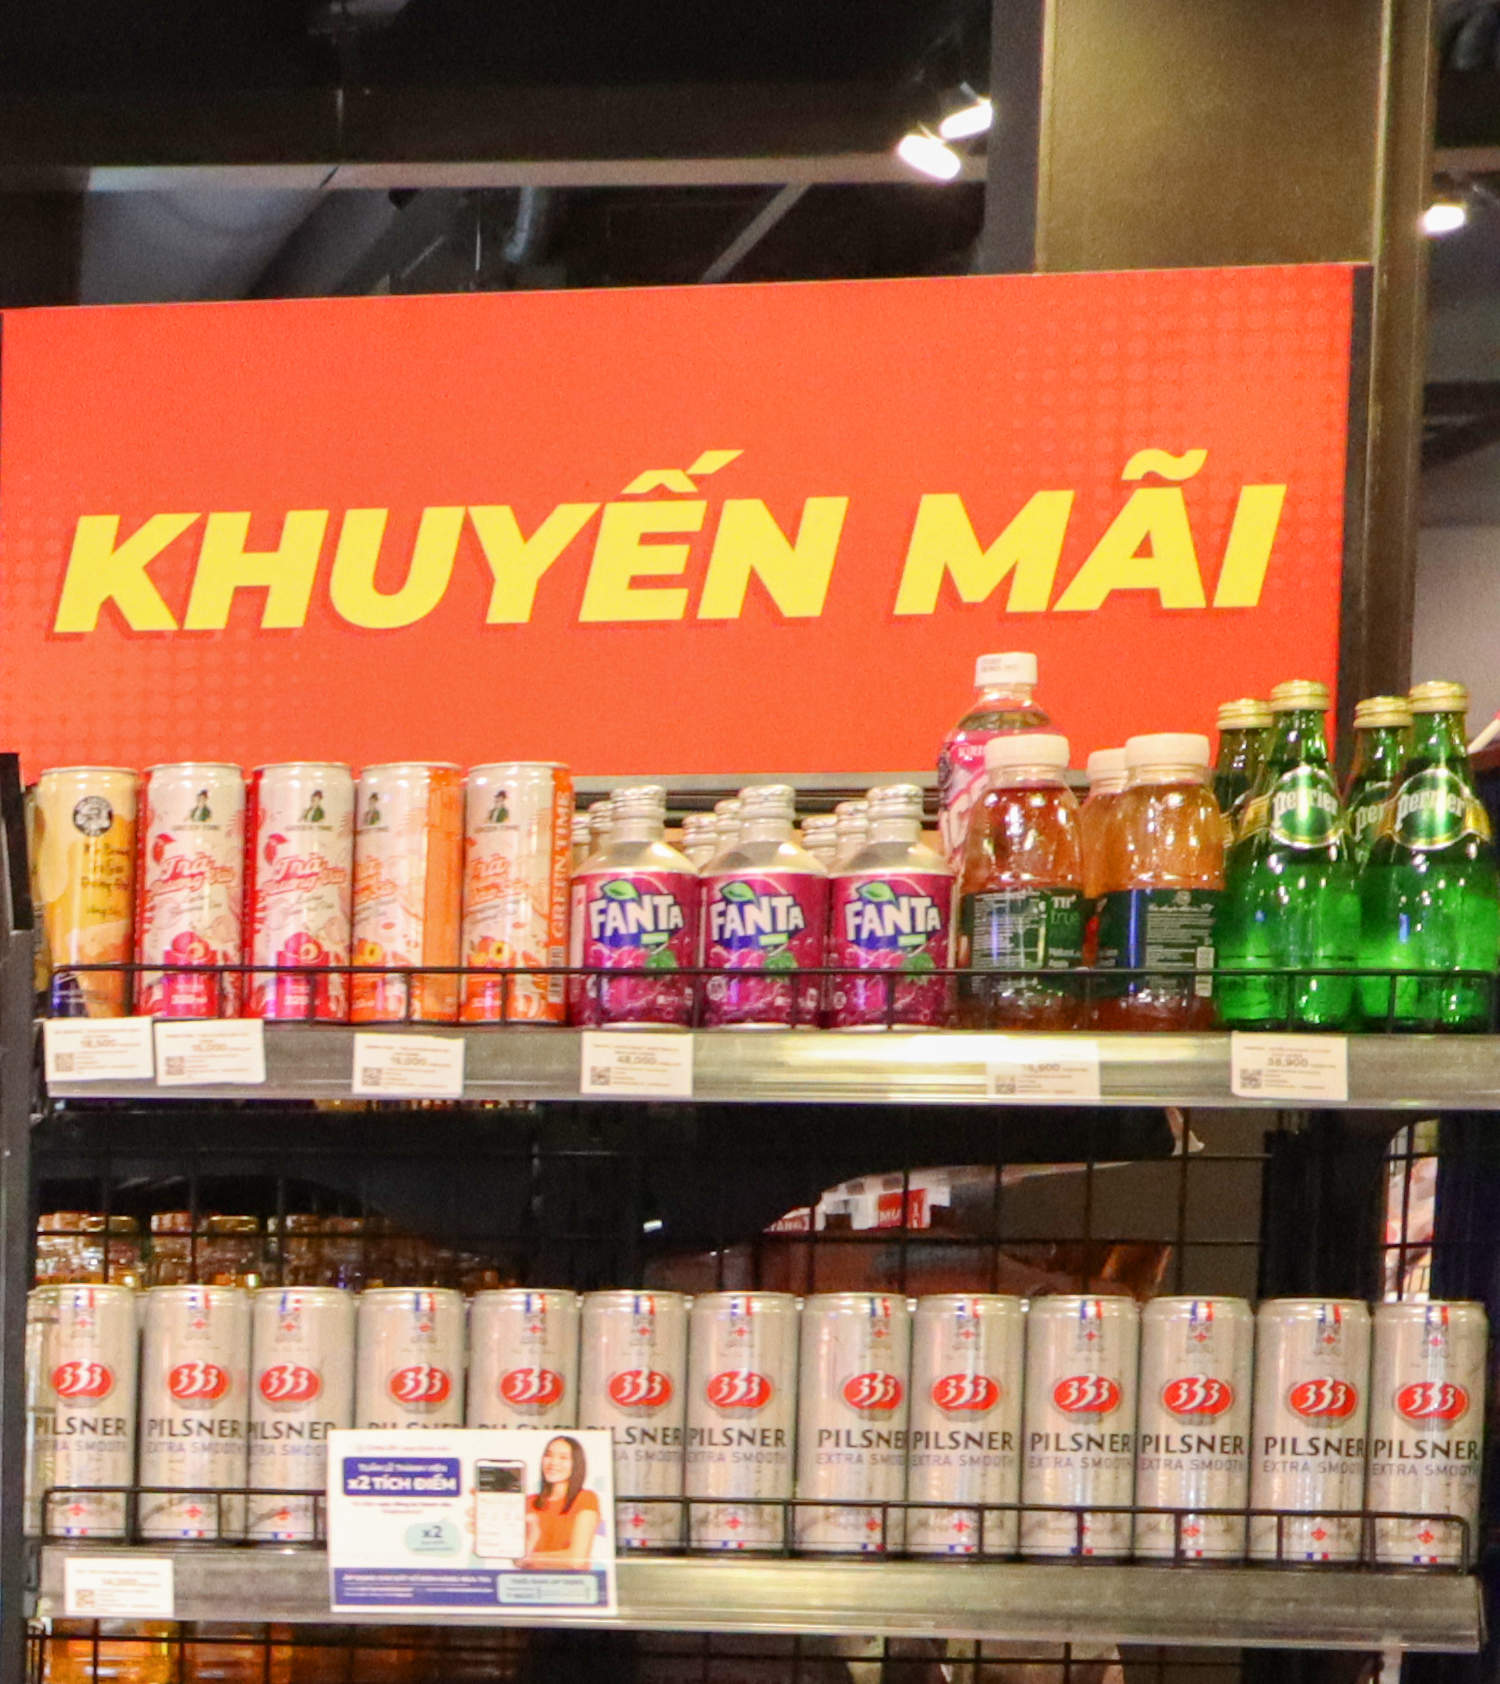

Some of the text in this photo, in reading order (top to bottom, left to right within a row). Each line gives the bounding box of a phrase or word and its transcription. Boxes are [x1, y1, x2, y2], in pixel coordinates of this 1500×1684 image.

[54, 449, 1286, 633] KHUYẾN MÃI
[589, 892, 685, 939] FANTA
[709, 893, 805, 940] FANTA
[844, 893, 942, 940] FANTA
[58, 1360, 108, 1396] 333
[175, 1360, 219, 1396] 333
[266, 1363, 310, 1398] 333
[398, 1364, 443, 1399] 333
[509, 1367, 553, 1402] 333
[620, 1368, 664, 1402] 333
[717, 1368, 761, 1404] 333
[856, 1370, 898, 1407] 333
[944, 1371, 989, 1409] 333
[1064, 1373, 1109, 1410] 333
[1176, 1375, 1222, 1411] 333
[1302, 1376, 1346, 1414] 333
[1409, 1379, 1456, 1416] 333
[35, 1416, 126, 1437] PILSNER
[150, 1418, 244, 1438] PILSNER
[688, 1427, 786, 1448] PILSNER
[912, 1431, 1013, 1450] PILSNER
[1031, 1432, 1132, 1454] PILSNER
[1141, 1434, 1245, 1456] PILSNER
[1263, 1436, 1365, 1458] PILSNER
[1373, 1439, 1478, 1462] PILSNER
[347, 1476, 370, 1490] x2
[374, 1475, 411, 1490] TÍCH
[423, 1526, 443, 1538] x2
